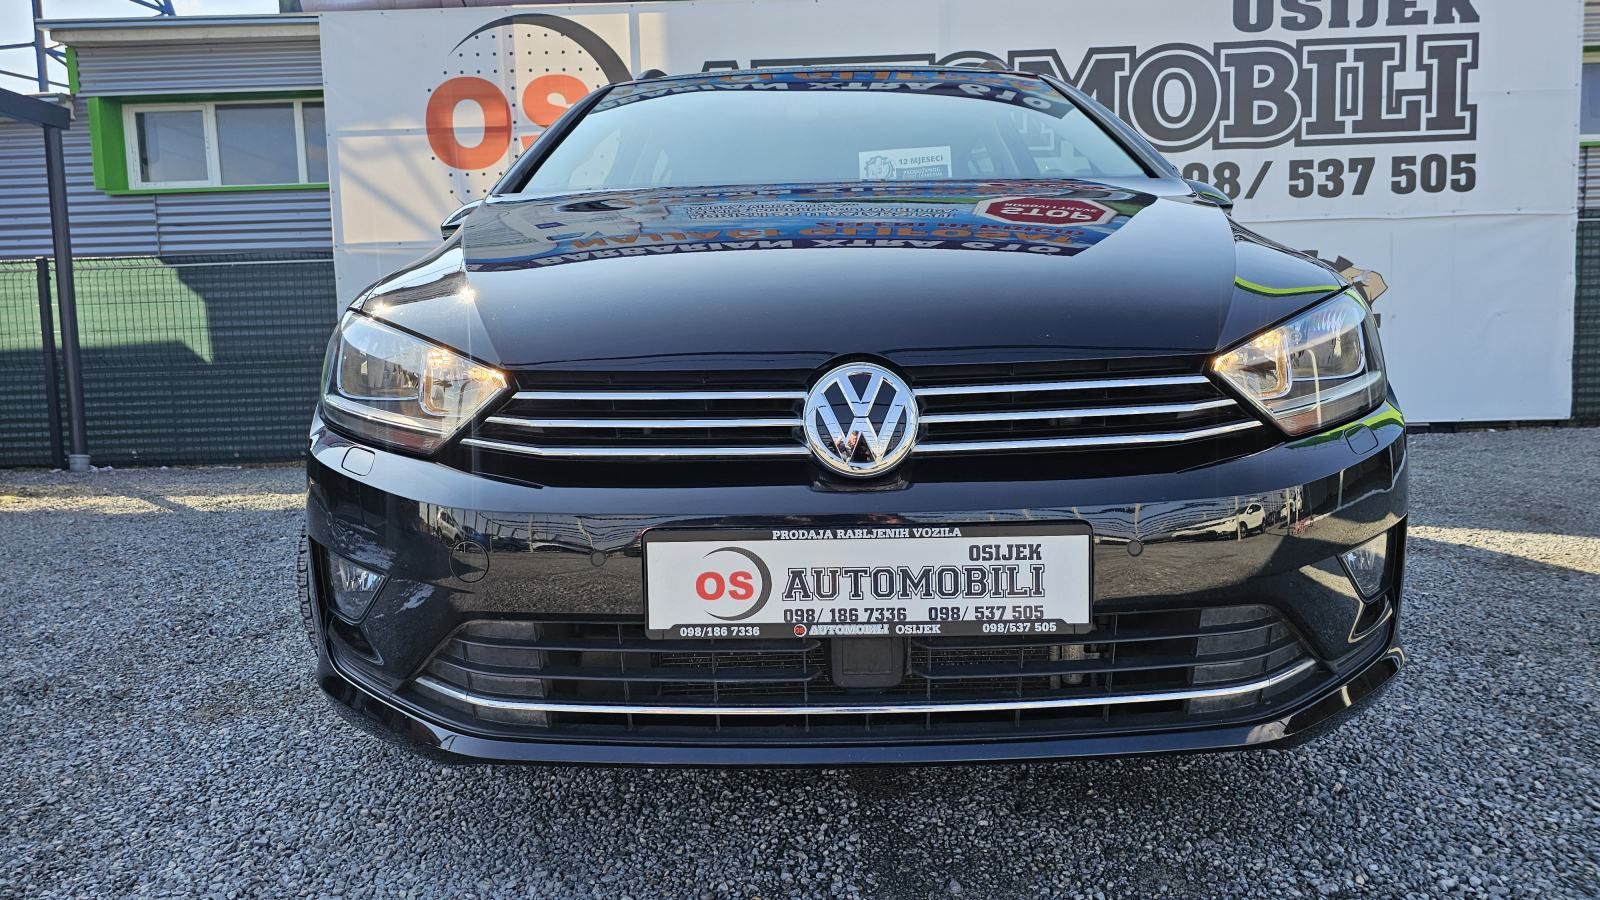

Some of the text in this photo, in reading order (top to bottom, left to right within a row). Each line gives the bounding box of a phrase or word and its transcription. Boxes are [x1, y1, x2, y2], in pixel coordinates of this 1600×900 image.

[899, 154, 944, 166] 12 MJESECI
[1288, 157, 1376, 198] 537
[1390, 153, 1477, 195] 505
[772, 527, 962, 541] PRODAJA RABLJENIH VOZILA
[968, 543, 1042, 562] OSIJEK
[695, 570, 754, 601] OS
[782, 564, 1046, 602] AUTOMOBILI
[783, 607, 907, 624] 098/ 186 7336
[928, 604, 1044, 622] 098/ 537 505
[679, 626, 760, 637] 098/186 7336
[808, 623, 889, 636] AUTOMOBILI
[895, 624, 942, 635] OSIJEK
[982, 622, 1057, 634] 098/537 505
